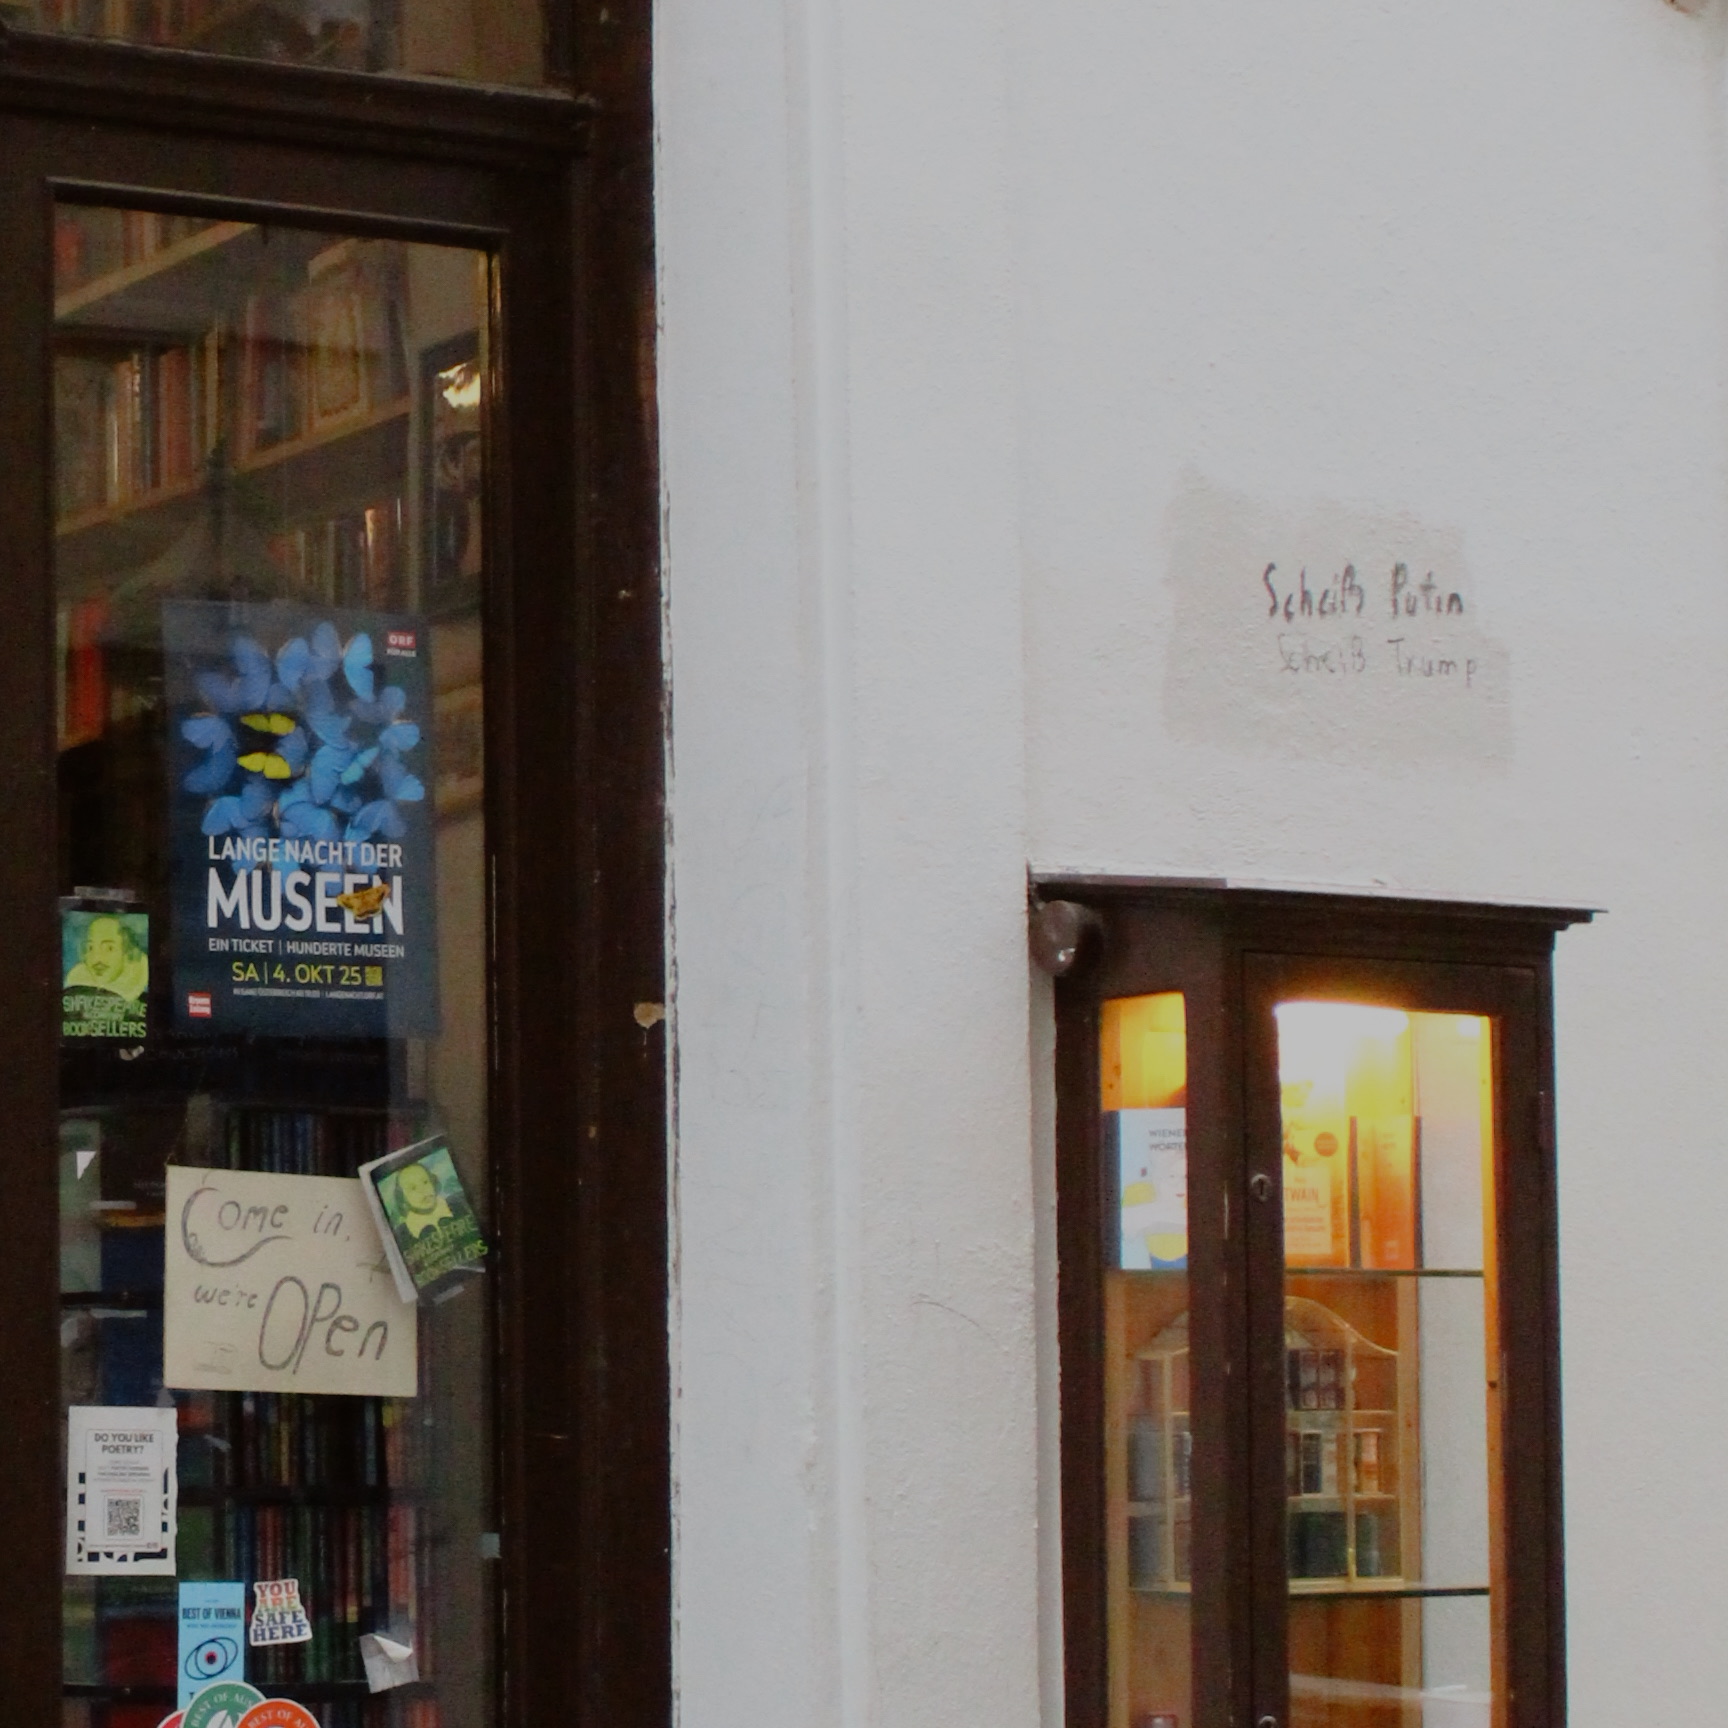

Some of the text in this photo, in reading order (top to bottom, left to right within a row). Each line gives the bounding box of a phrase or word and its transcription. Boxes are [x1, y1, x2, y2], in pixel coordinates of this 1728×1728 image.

[1391, 562, 1464, 618] Putin
[389, 635, 414, 646] ORF
[1387, 637, 1477, 689] Trump
[208, 835, 403, 868] LANGE NACHT DER
[206, 866, 405, 936] MUSEEN
[208, 938, 405, 958] EIN TICKET HUNDERTE MUSEEN
[231, 961, 362, 985] SA 4. OKT 25
[181, 1187, 293, 1268] Come
[94, 1432, 155, 1443] DO YOU LIKE
[101, 1444, 145, 1455] POETRY?
[257, 1580, 297, 1598] YOU
[259, 1595, 298, 1612] ARE
[182, 1607, 242, 1621] BEST OF VIENNA
[255, 1610, 304, 1628] SAFE
[252, 1622, 307, 1643] HERE
[190, 1700, 211, 1728] BEST
[213, 1692, 228, 1703] OF
[276, 1709, 294, 1720] OF
